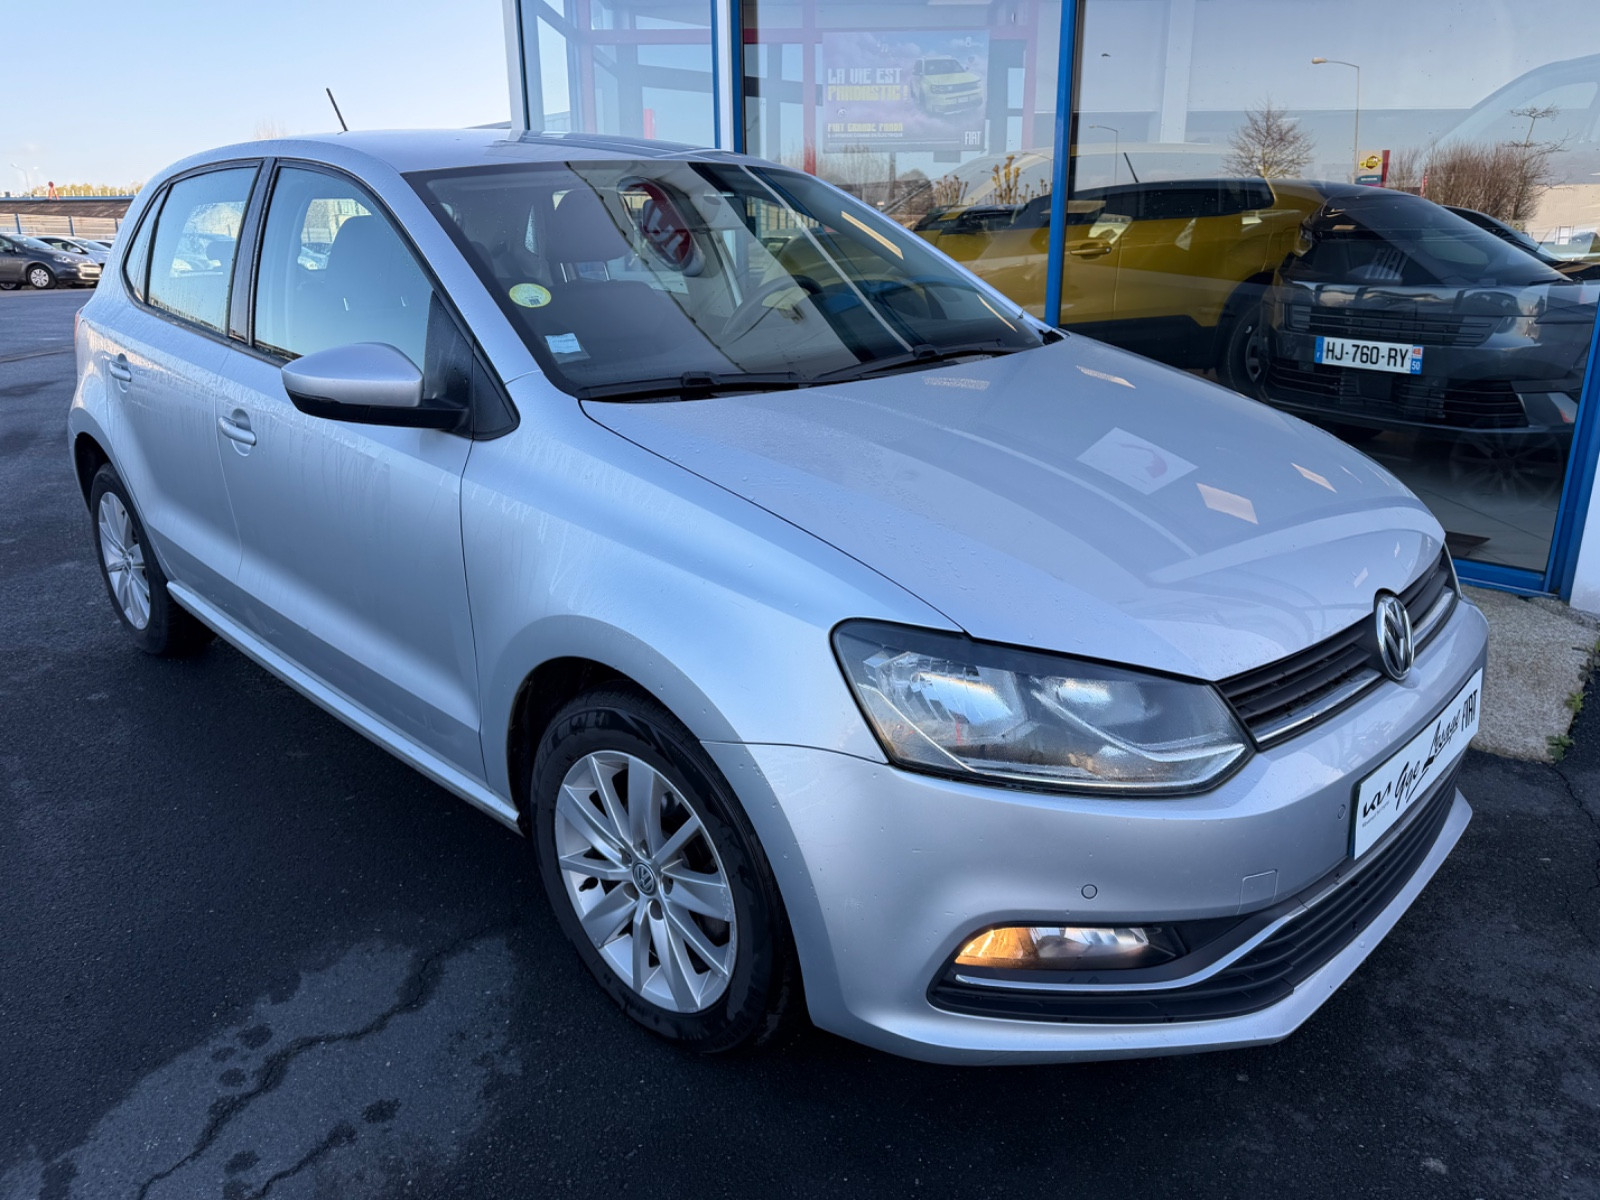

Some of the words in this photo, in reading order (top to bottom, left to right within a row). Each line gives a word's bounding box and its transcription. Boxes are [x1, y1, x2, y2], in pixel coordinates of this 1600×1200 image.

[828, 69, 845, 84] LA
[876, 67, 902, 84] EST
[964, 131, 982, 145] FIAT
[1325, 341, 1409, 368] HJ-760-RY
[1411, 361, 1421, 371] 50
[1461, 688, 1478, 732] FIAT
